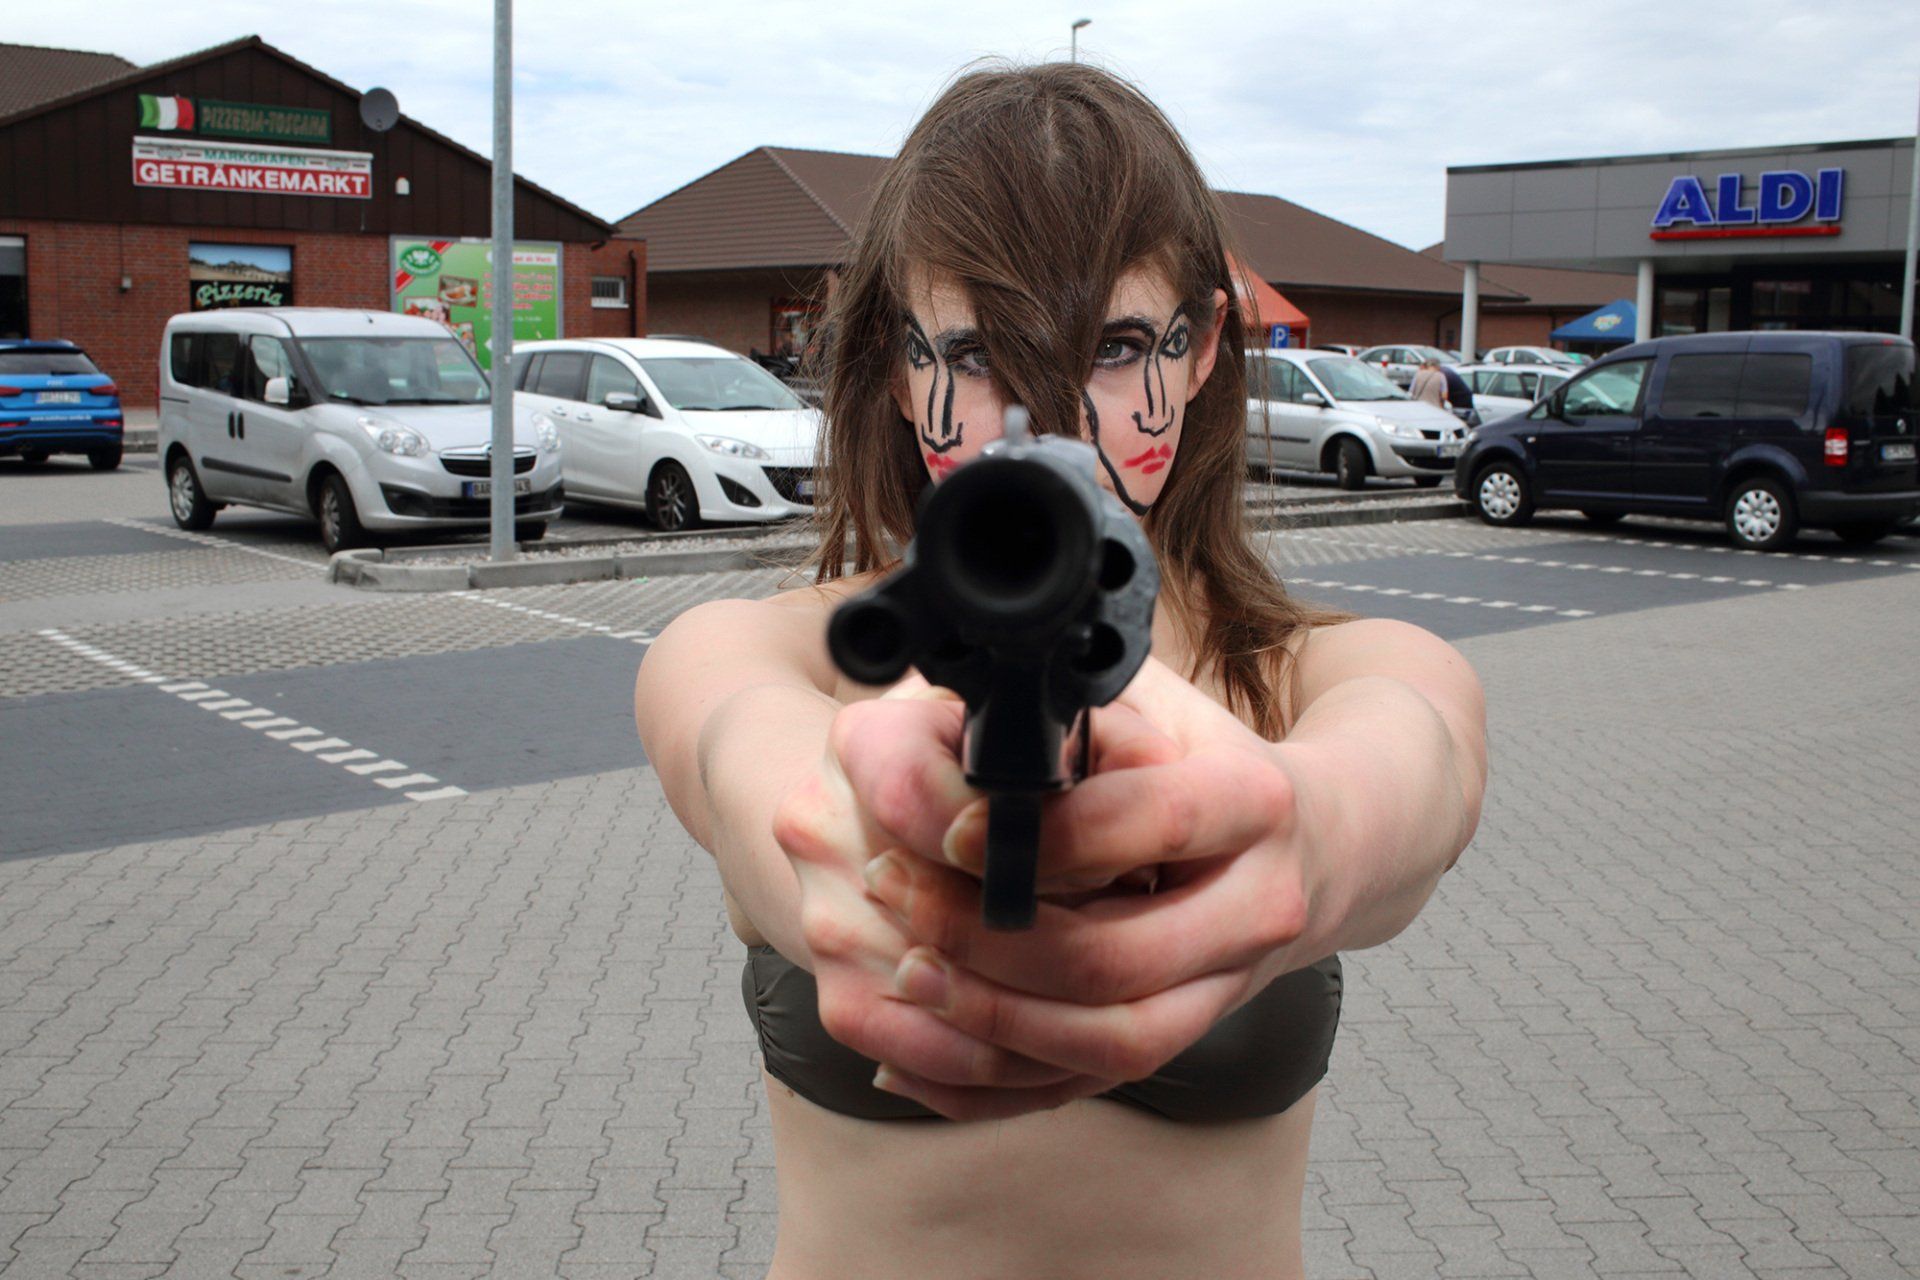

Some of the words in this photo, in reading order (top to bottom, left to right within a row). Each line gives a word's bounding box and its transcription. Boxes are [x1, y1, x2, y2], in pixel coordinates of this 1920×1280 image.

[204, 149, 307, 167] MARKGRAFEN
[140, 162, 366, 194] GETRÄNKEMARKT
[1651, 167, 1843, 227] ALDI
[196, 281, 283, 306] Pizzeria
